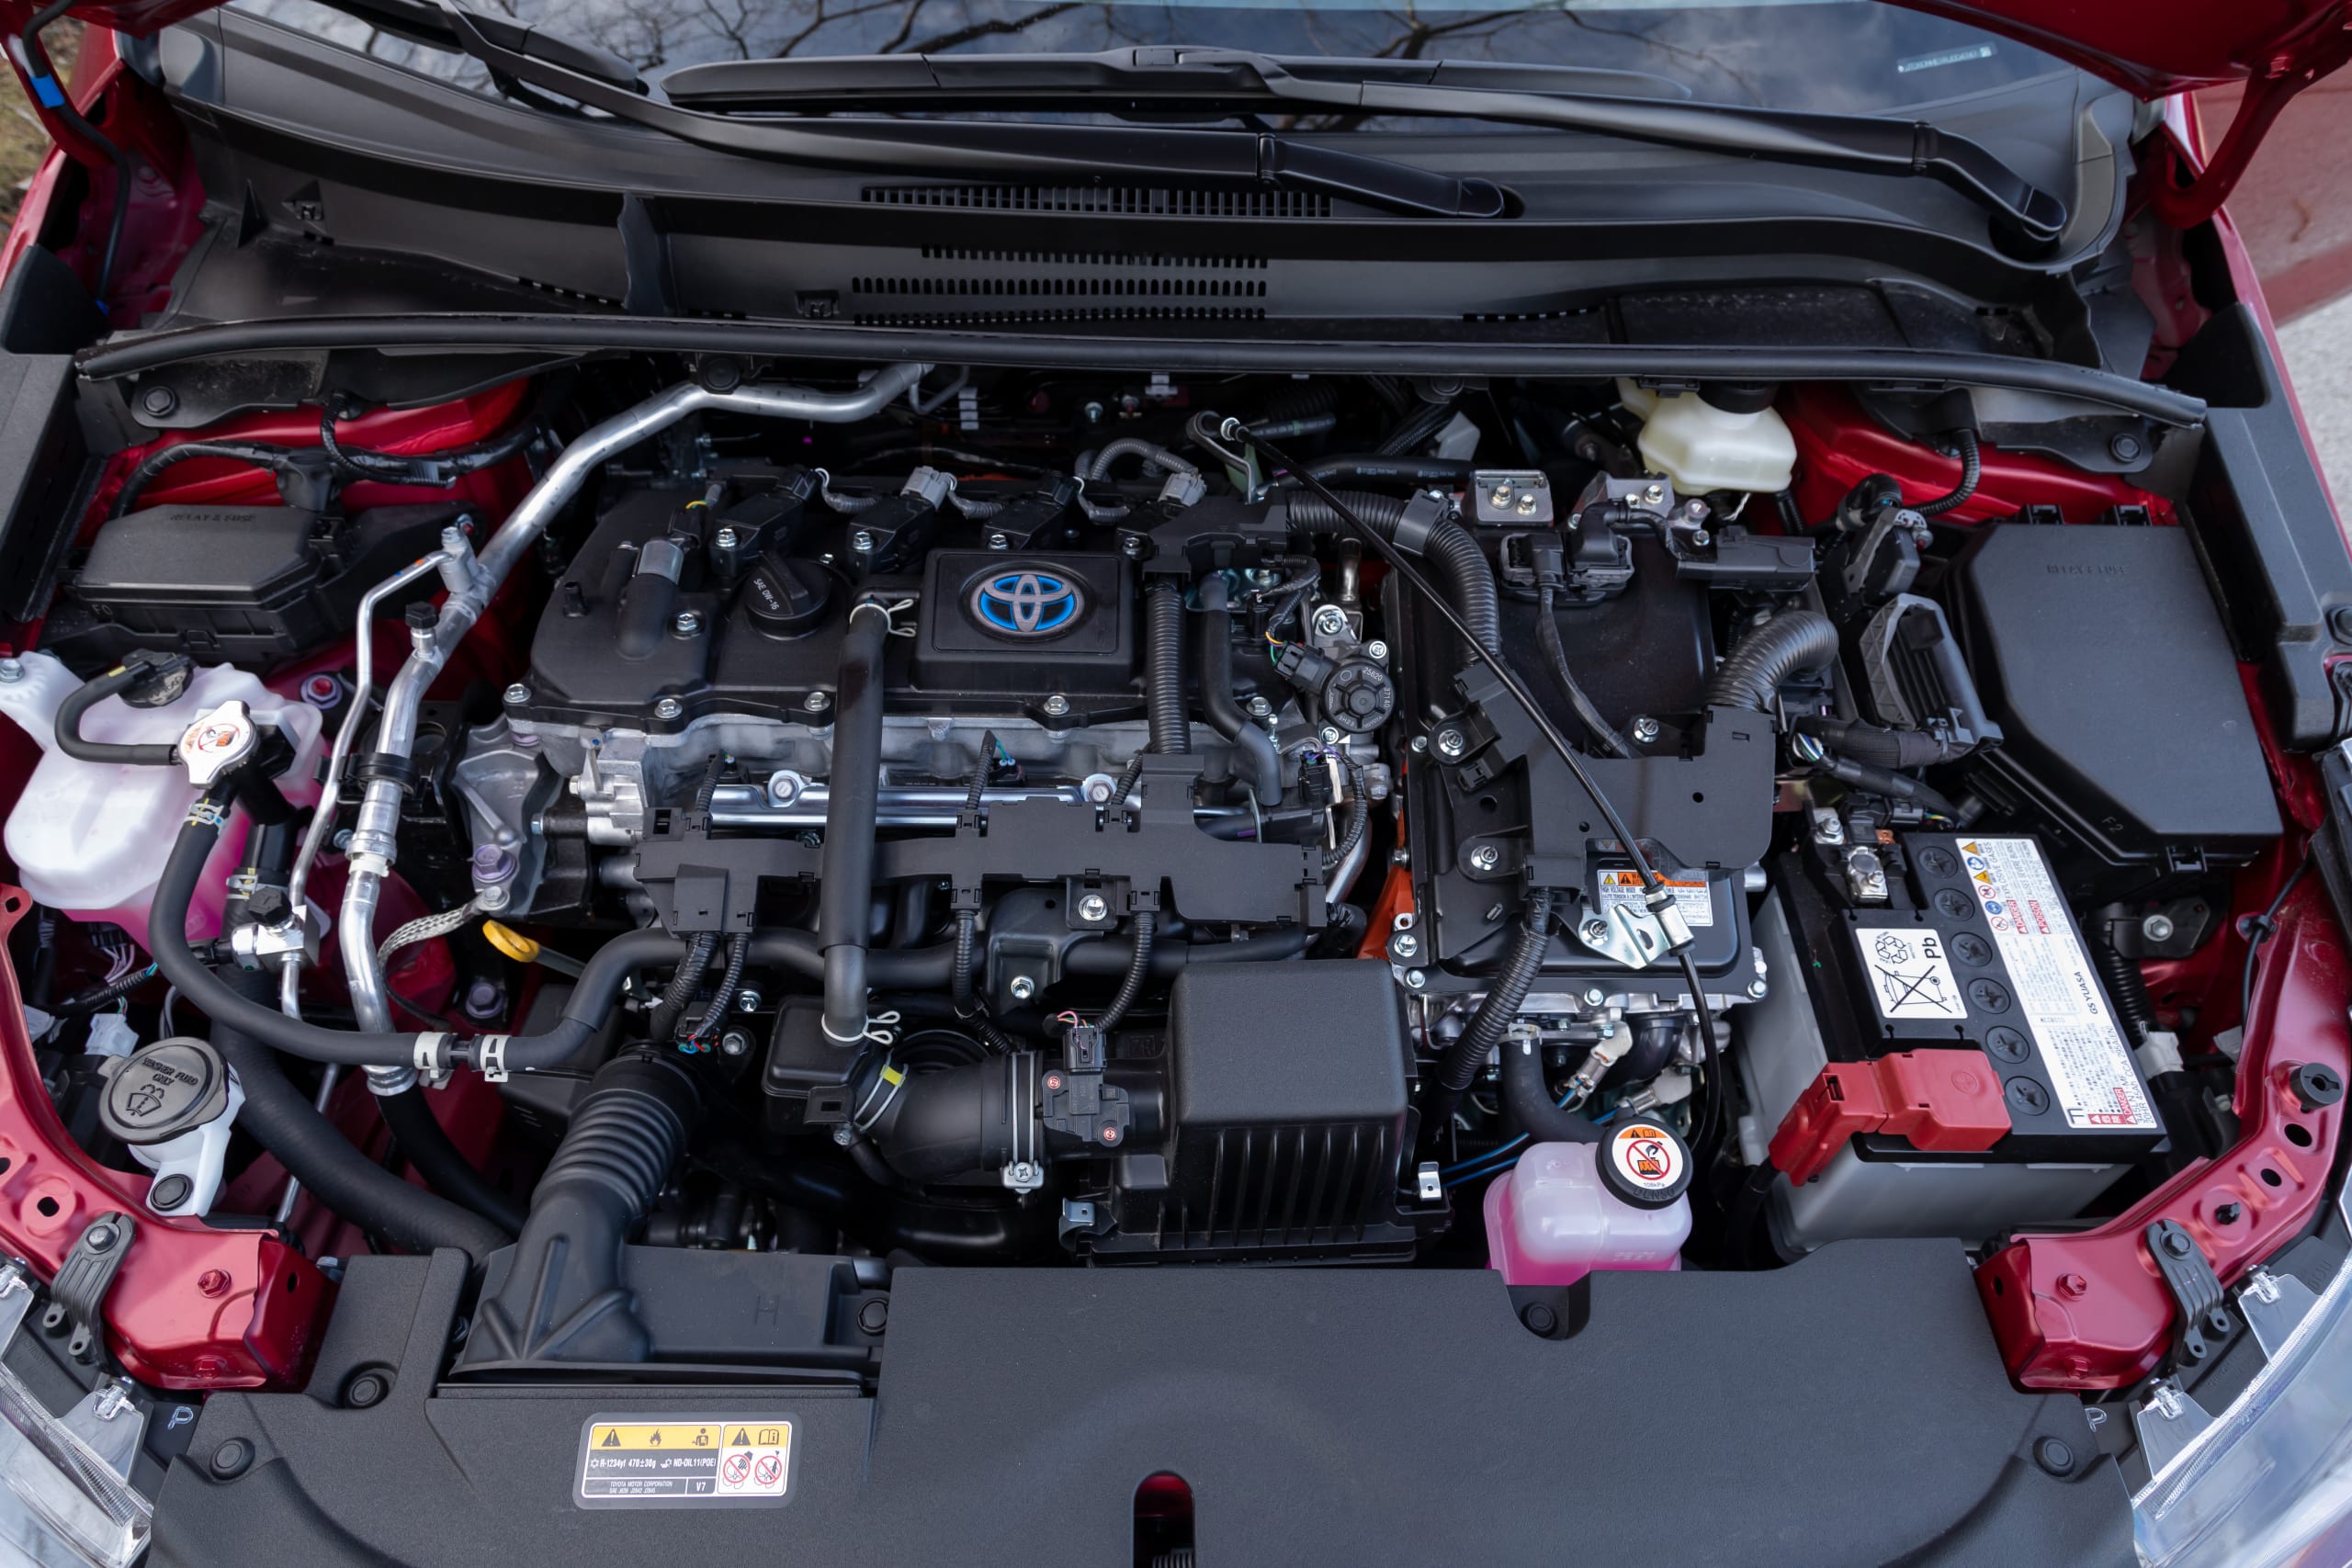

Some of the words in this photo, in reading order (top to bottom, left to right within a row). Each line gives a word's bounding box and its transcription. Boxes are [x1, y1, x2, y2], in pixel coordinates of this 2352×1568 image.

[753, 578, 766, 590] SAE
[762, 589, 779, 610] 0W-16
[1363, 667, 1383, 682] 25620
[1922, 937, 1942, 958] Pb
[2072, 971, 2093, 1000] YUASA
[2086, 1002, 2098, 1014] GS
[141, 1057, 175, 1076] WASHER
[175, 1071, 198, 1086] FLUID
[152, 1073, 175, 1086] ONLY
[2114, 1088, 2132, 1114] DANGER
[599, 1458, 627, 1469] R-1234yf
[628, 1458, 657, 1469] 470±30g
[695, 1482, 707, 1492] V7
